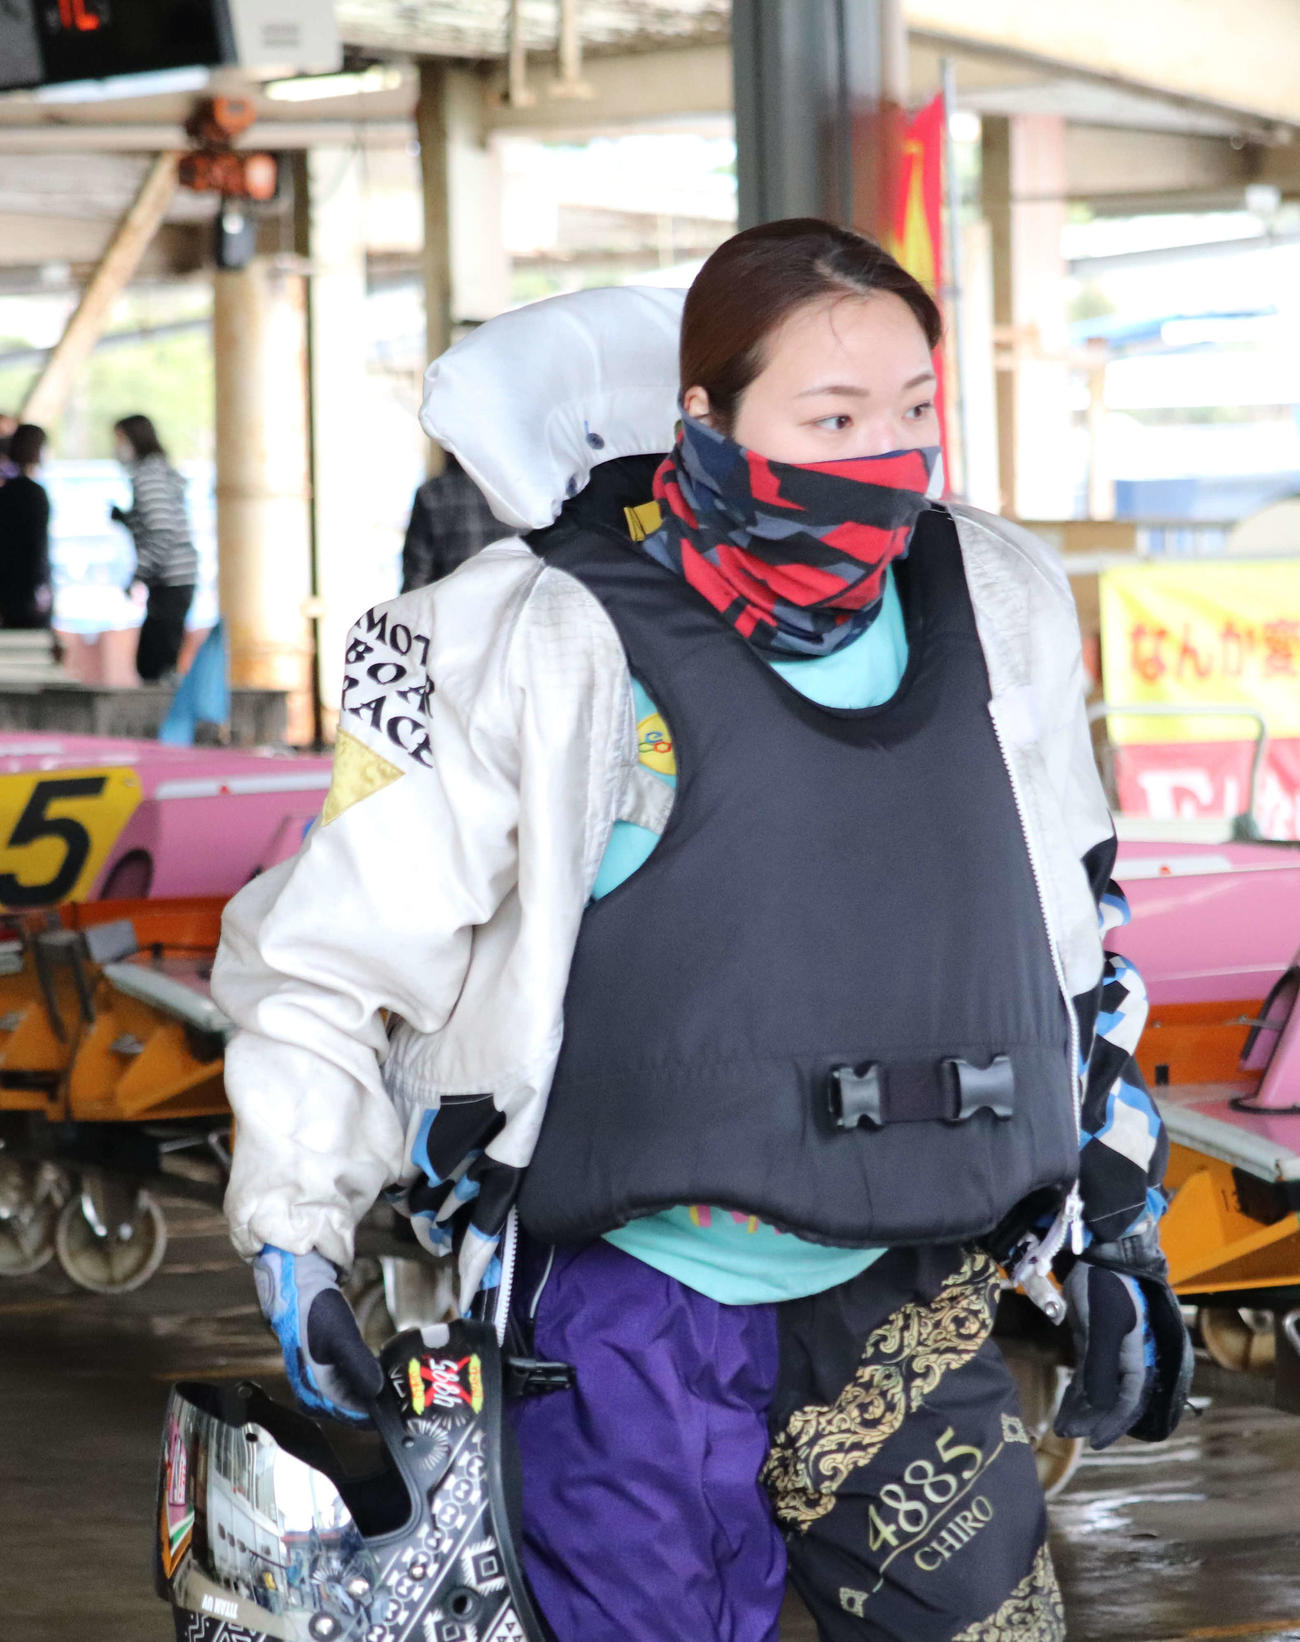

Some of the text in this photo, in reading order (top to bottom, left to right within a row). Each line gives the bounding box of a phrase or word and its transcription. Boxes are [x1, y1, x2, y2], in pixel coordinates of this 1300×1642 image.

[345, 637, 435, 719] BOA
[0, 776, 108, 906] 5
[867, 1426, 983, 1551] 4885
[914, 1495, 994, 1571] CHIRO
